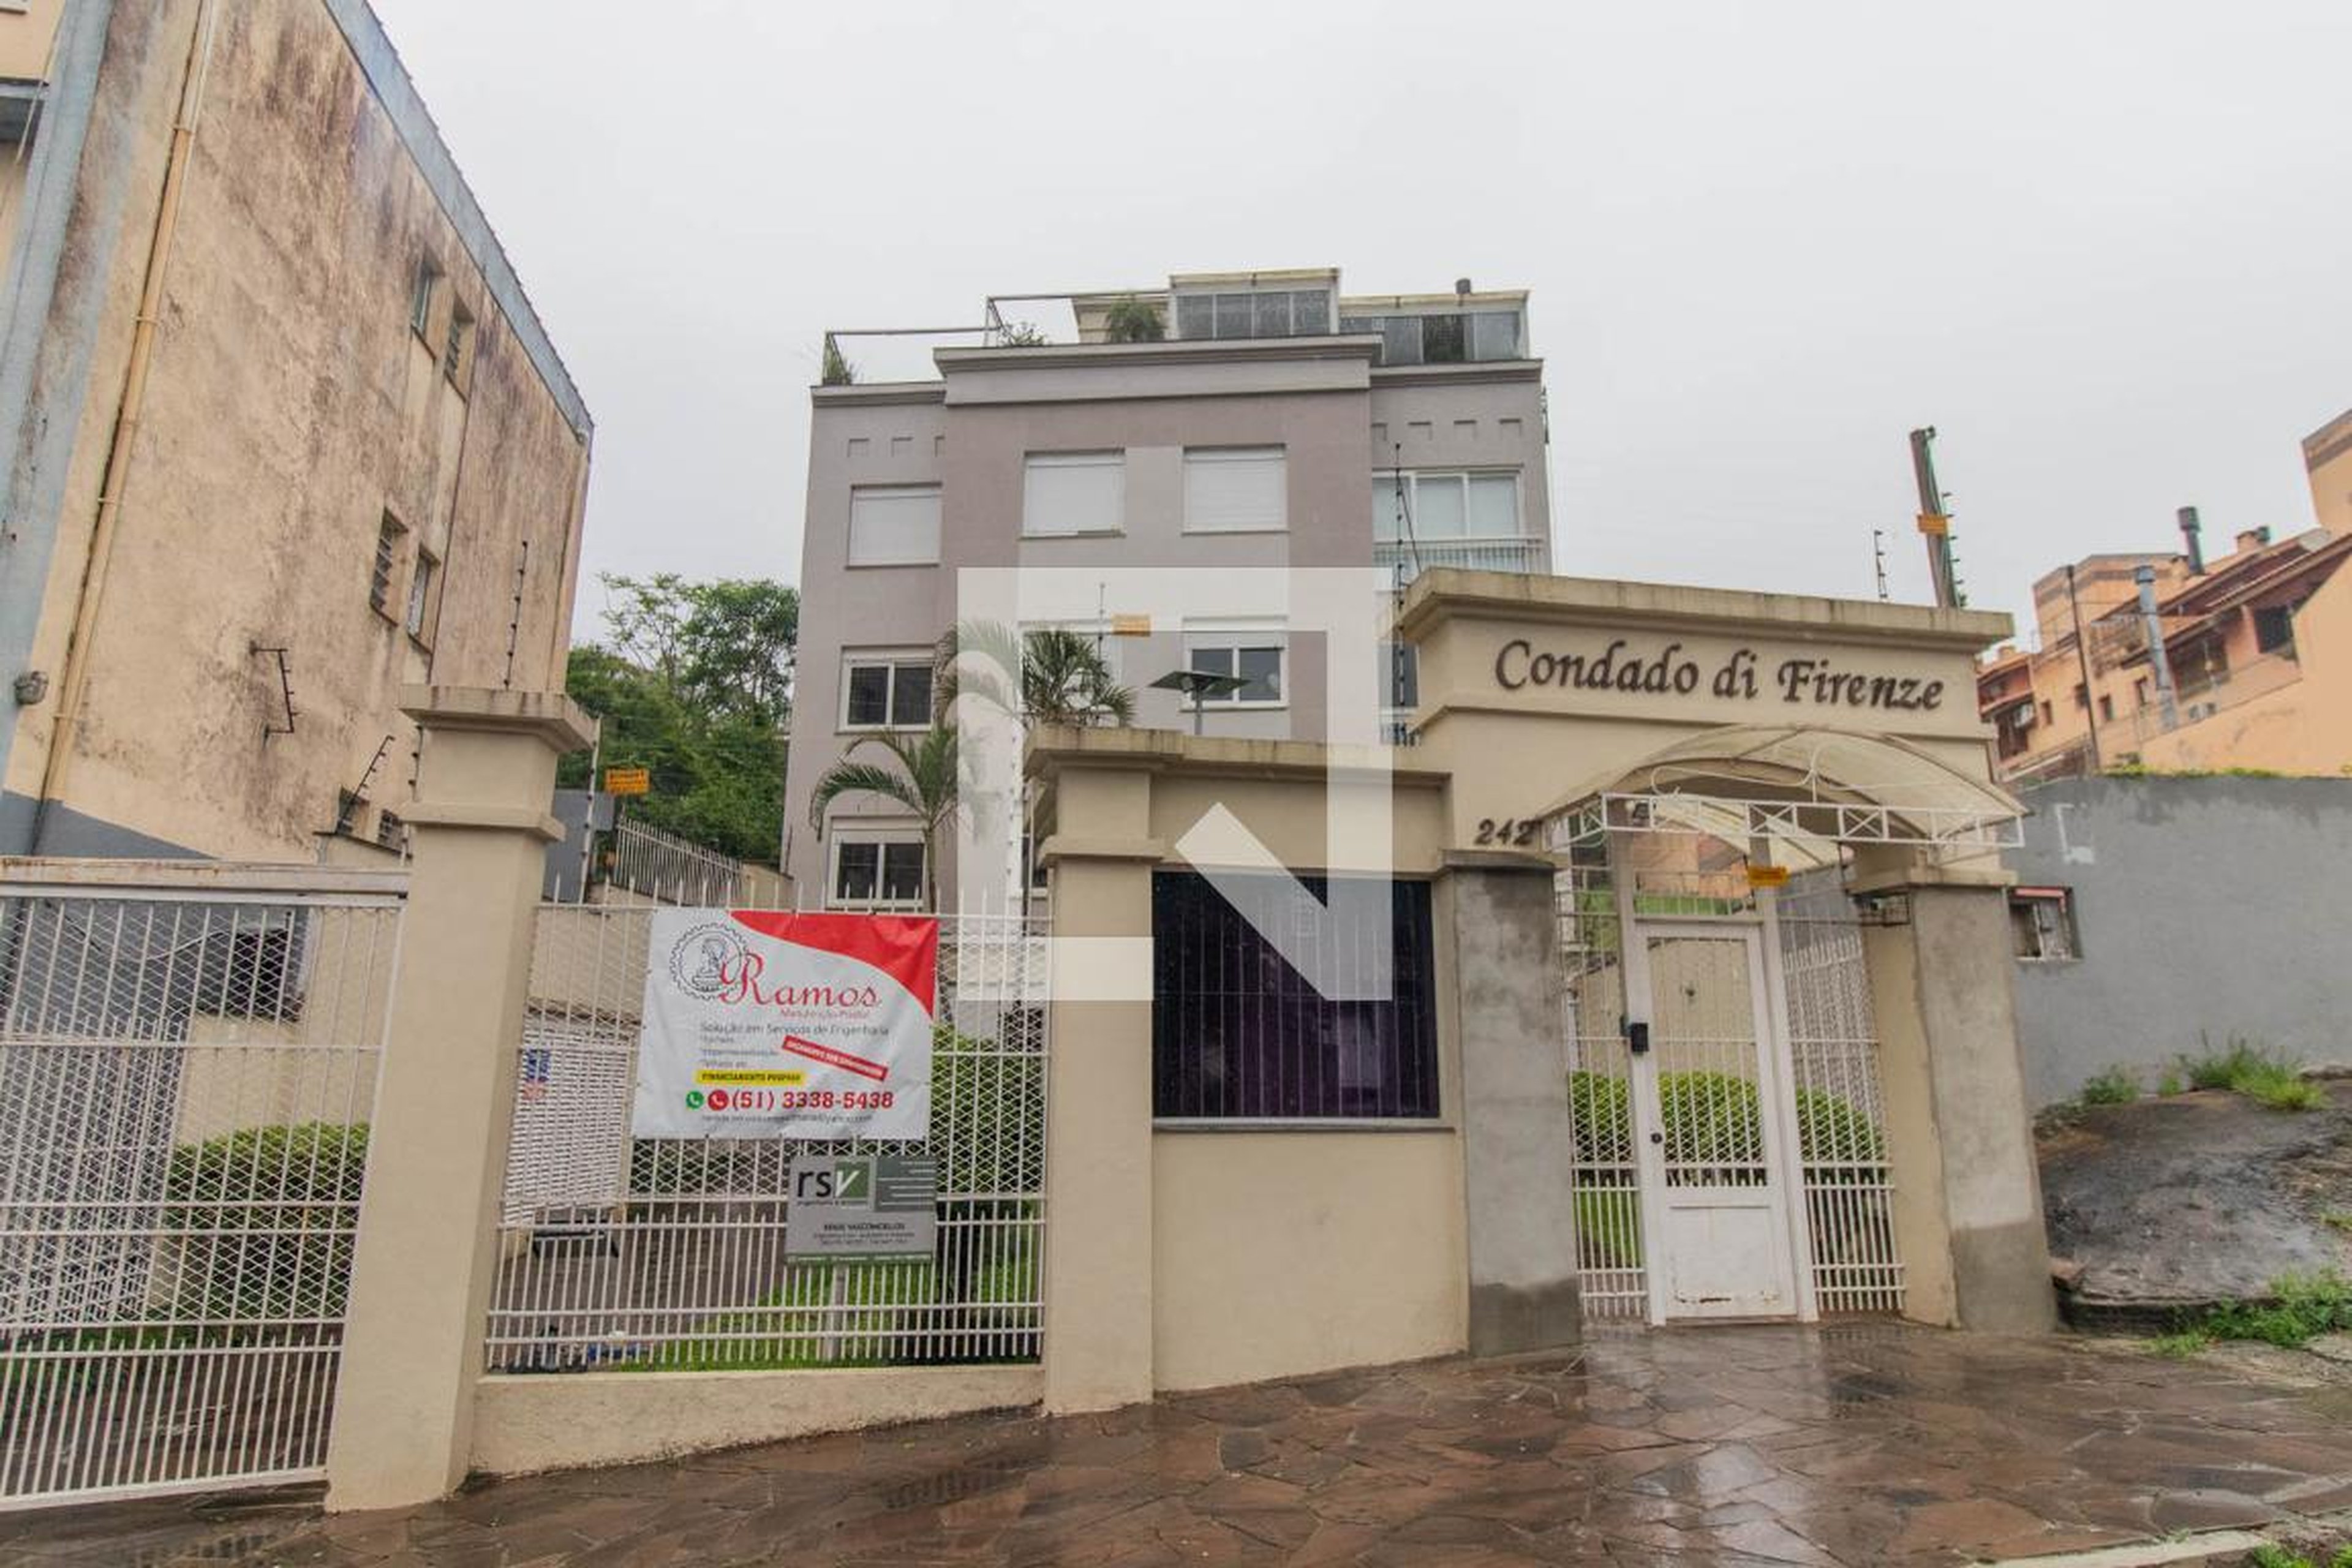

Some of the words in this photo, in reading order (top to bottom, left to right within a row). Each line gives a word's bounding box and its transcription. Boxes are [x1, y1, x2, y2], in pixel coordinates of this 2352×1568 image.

[1495, 639, 1700, 695] Condado
[1713, 648, 1758, 699] di
[1777, 659, 1944, 710] Firenze
[1474, 818, 1536, 846] 242
[718, 951, 882, 1007] Ramos
[733, 1090, 774, 1111] (51)
[782, 1091, 894, 1110] 3338-5438
